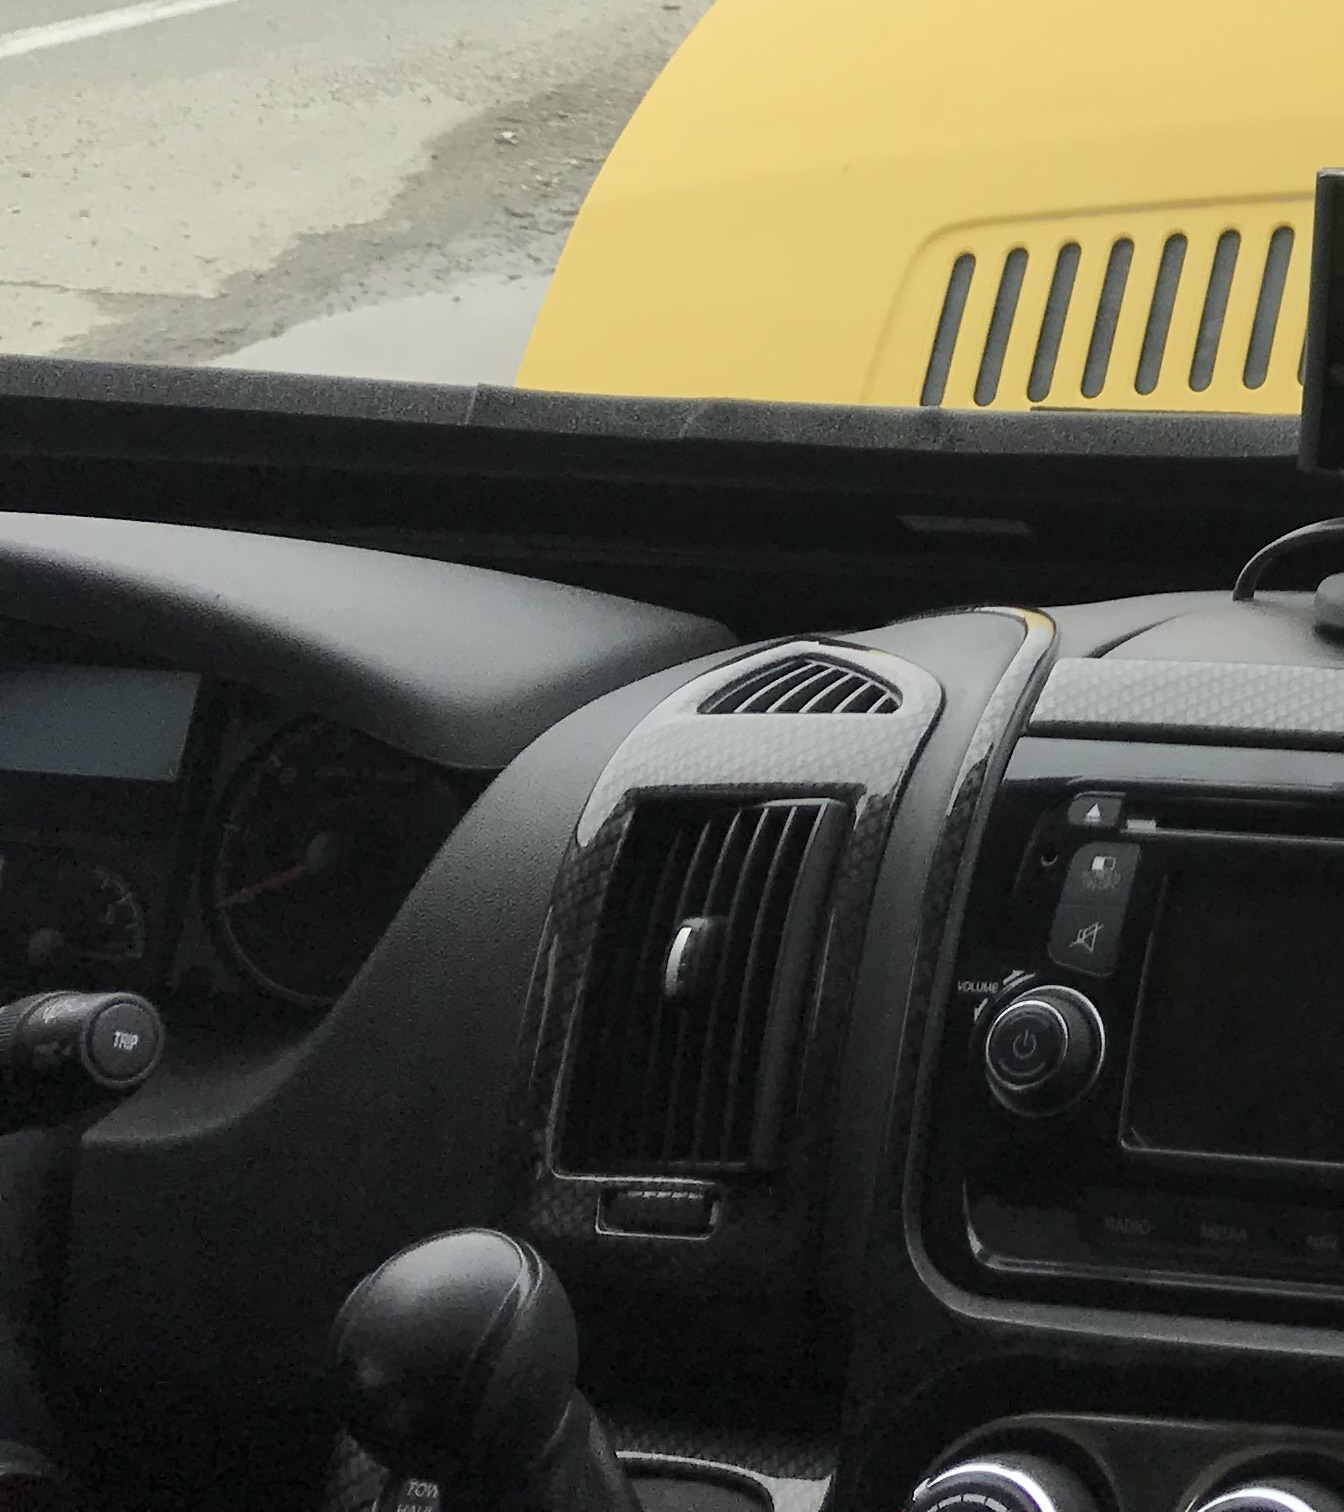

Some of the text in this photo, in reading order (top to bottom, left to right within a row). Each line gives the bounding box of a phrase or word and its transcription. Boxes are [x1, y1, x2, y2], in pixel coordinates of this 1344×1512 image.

[957, 979, 999, 994] VOLUME
[113, 1030, 138, 1051] TRIP
[1103, 1216, 1152, 1236] RADIO
